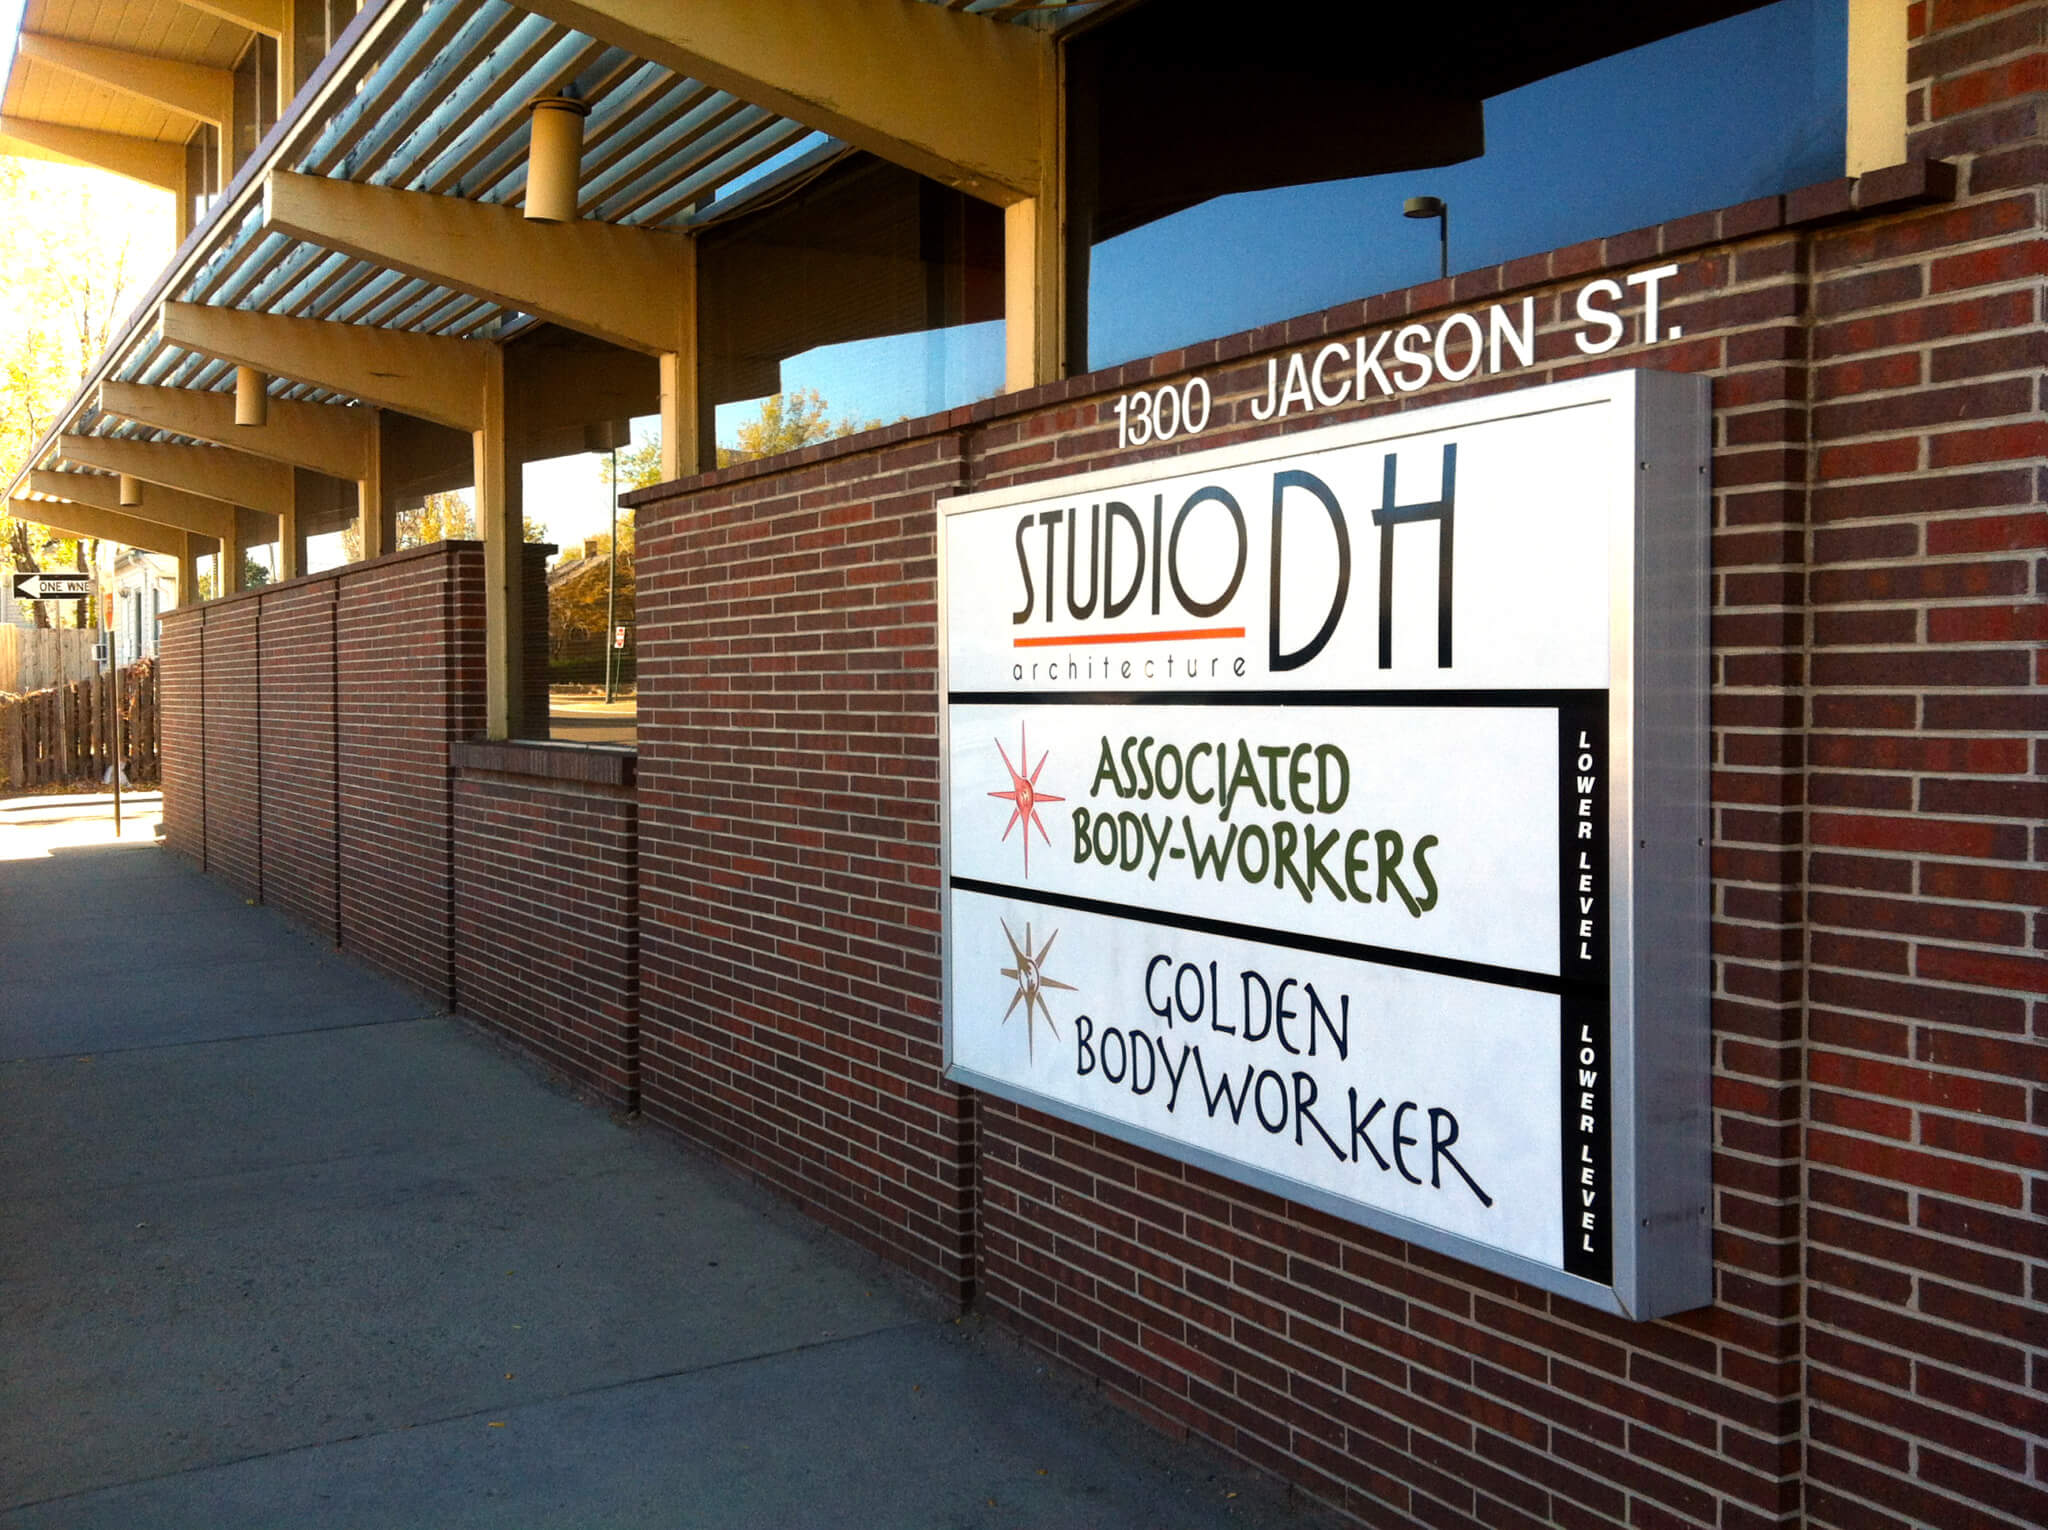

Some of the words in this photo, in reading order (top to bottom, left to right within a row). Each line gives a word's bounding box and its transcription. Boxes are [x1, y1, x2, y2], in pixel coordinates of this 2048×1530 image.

[1113, 377, 1211, 449] 1300
[1251, 296, 1535, 421] JACKSON
[1575, 264, 1682, 355] ST.
[39, 581, 63, 592] ONE
[1013, 485, 1248, 625] STUDIO
[1269, 443, 1457, 672] DH
[1013, 653, 1246, 681] architecture
[1090, 736, 1350, 821] ASSOCIATED
[1576, 731, 1595, 839] LOWER
[1072, 807, 1439, 918] BODY-WORKERS
[1579, 852, 1593, 960] LEVEL
[1145, 954, 1349, 1061] GOLDEN
[1075, 1015, 1493, 1208] BODYWORKER
[1579, 1024, 1597, 1133] LOWER
[1581, 1145, 1595, 1252] LEVEL
